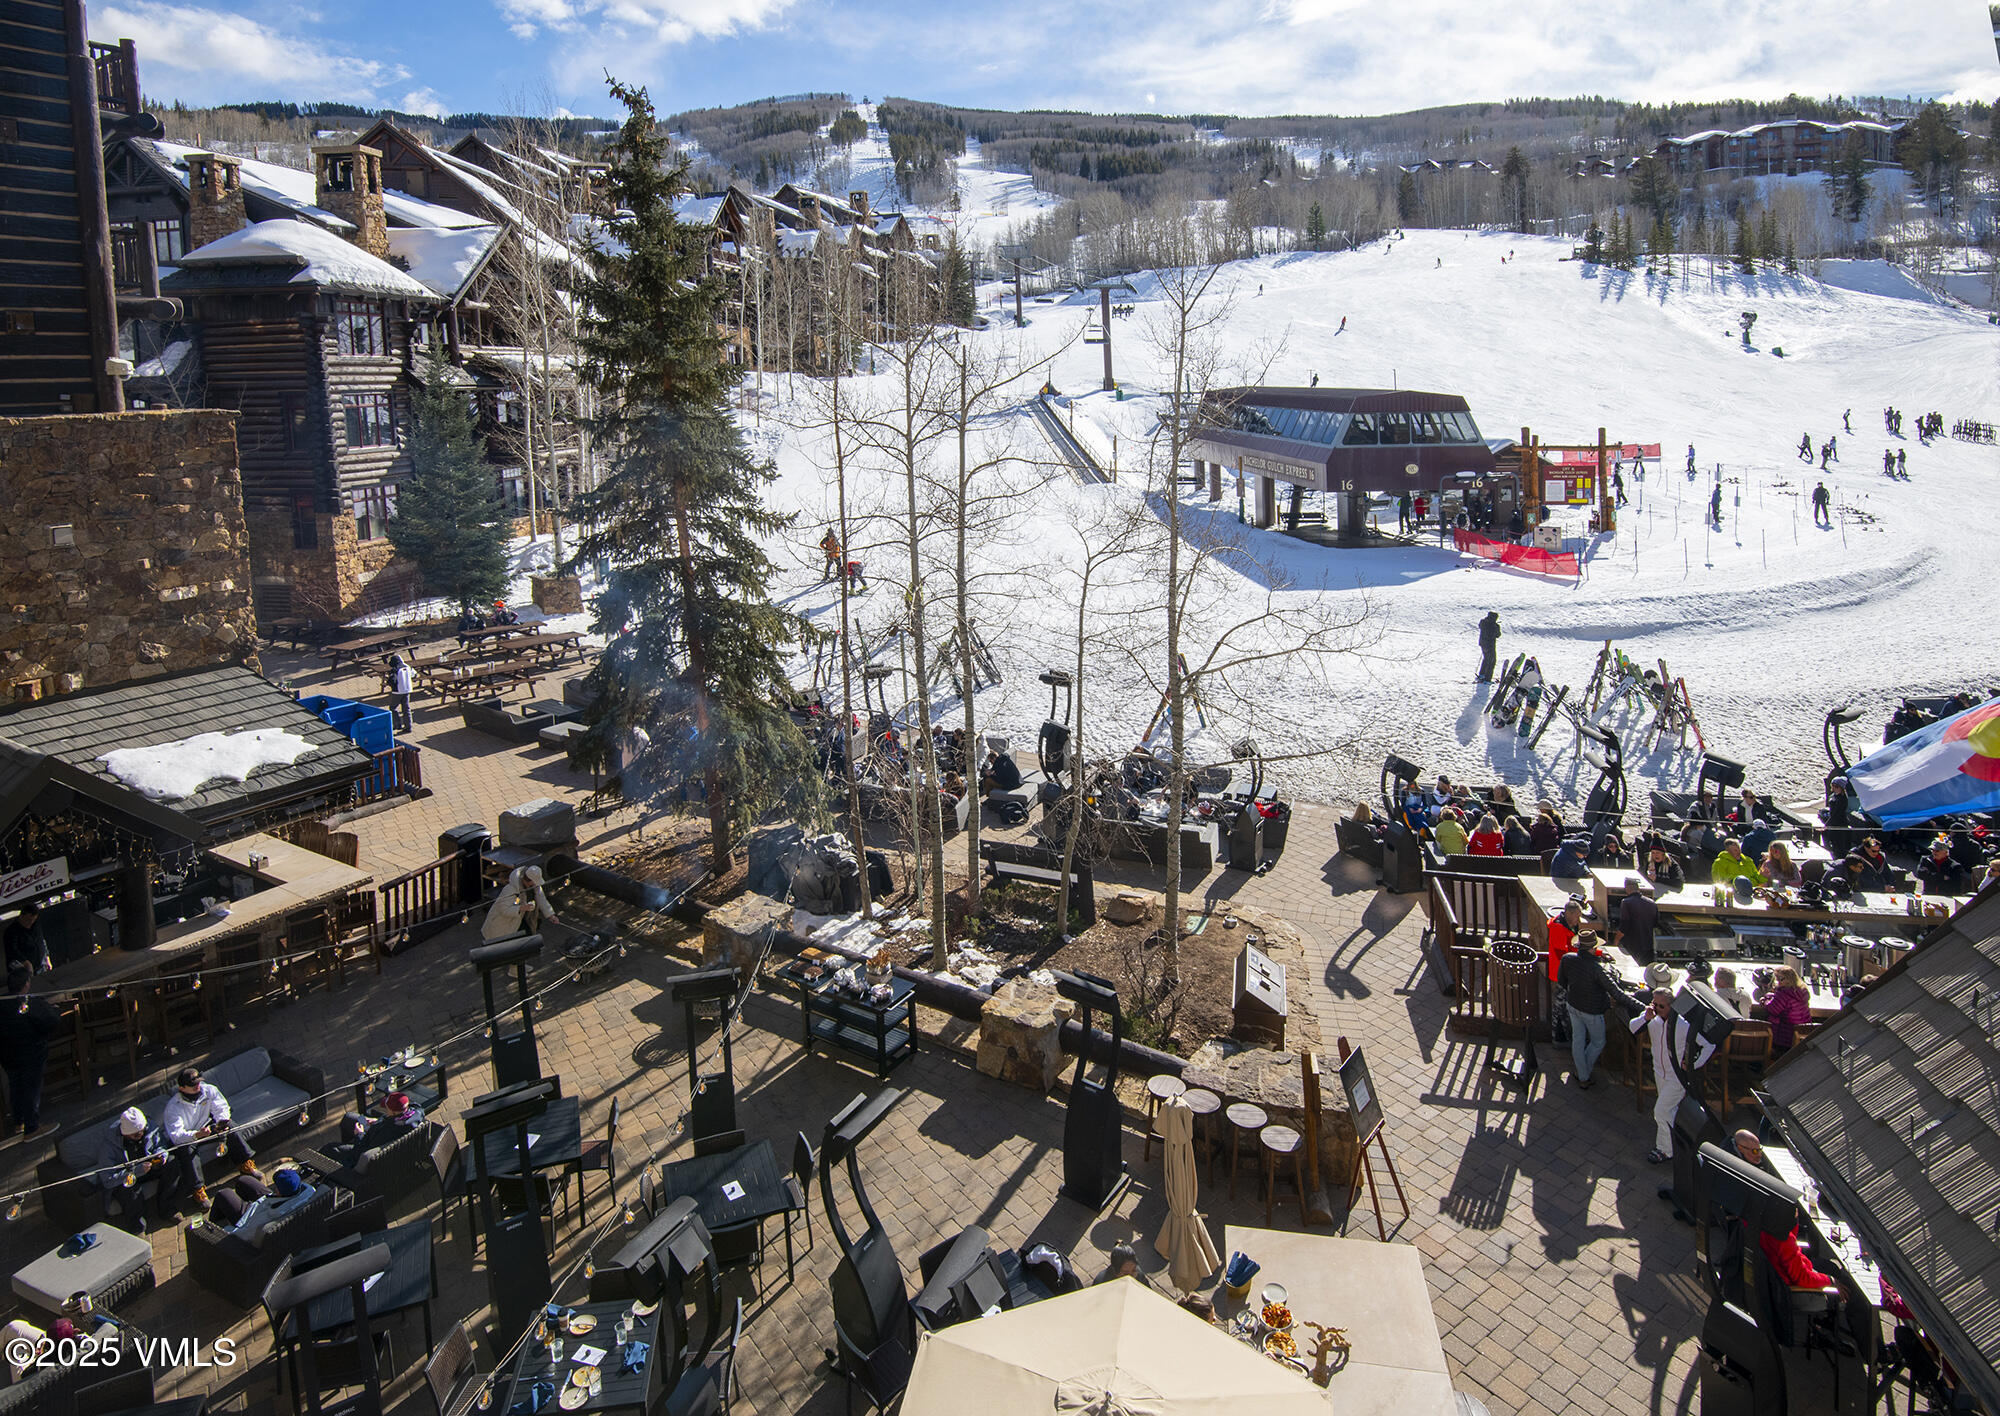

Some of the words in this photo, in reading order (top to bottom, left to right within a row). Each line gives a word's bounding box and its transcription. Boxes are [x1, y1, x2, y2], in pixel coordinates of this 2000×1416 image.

[1267, 460, 1285, 473] GULCH
[1285, 464, 1308, 479] EXPRESS
[1341, 479, 1353, 491] 16
[1472, 477, 1483, 488] 16
[35, 878, 63, 892] BEER
